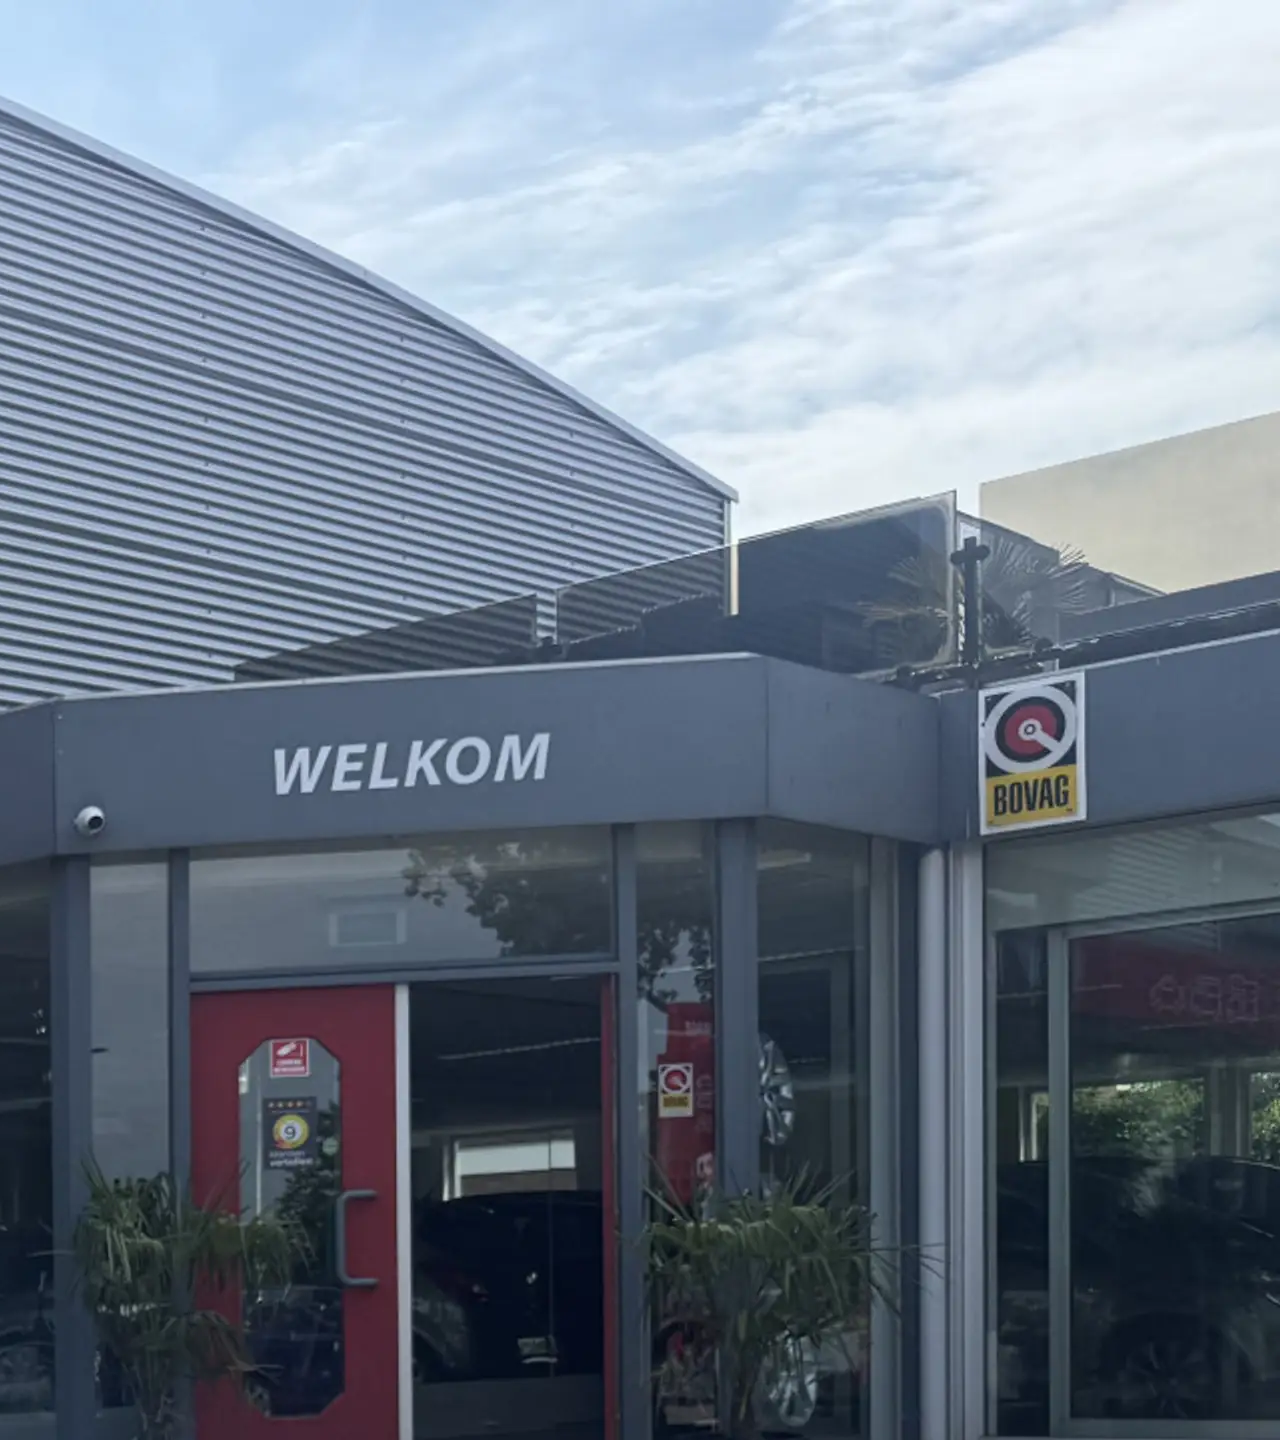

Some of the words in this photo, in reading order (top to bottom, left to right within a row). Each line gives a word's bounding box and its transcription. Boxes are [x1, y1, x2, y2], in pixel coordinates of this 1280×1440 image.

[272, 732, 551, 796] WELKOM
[993, 774, 1071, 817] BOVAG
[284, 1126, 296, 1140] 9
